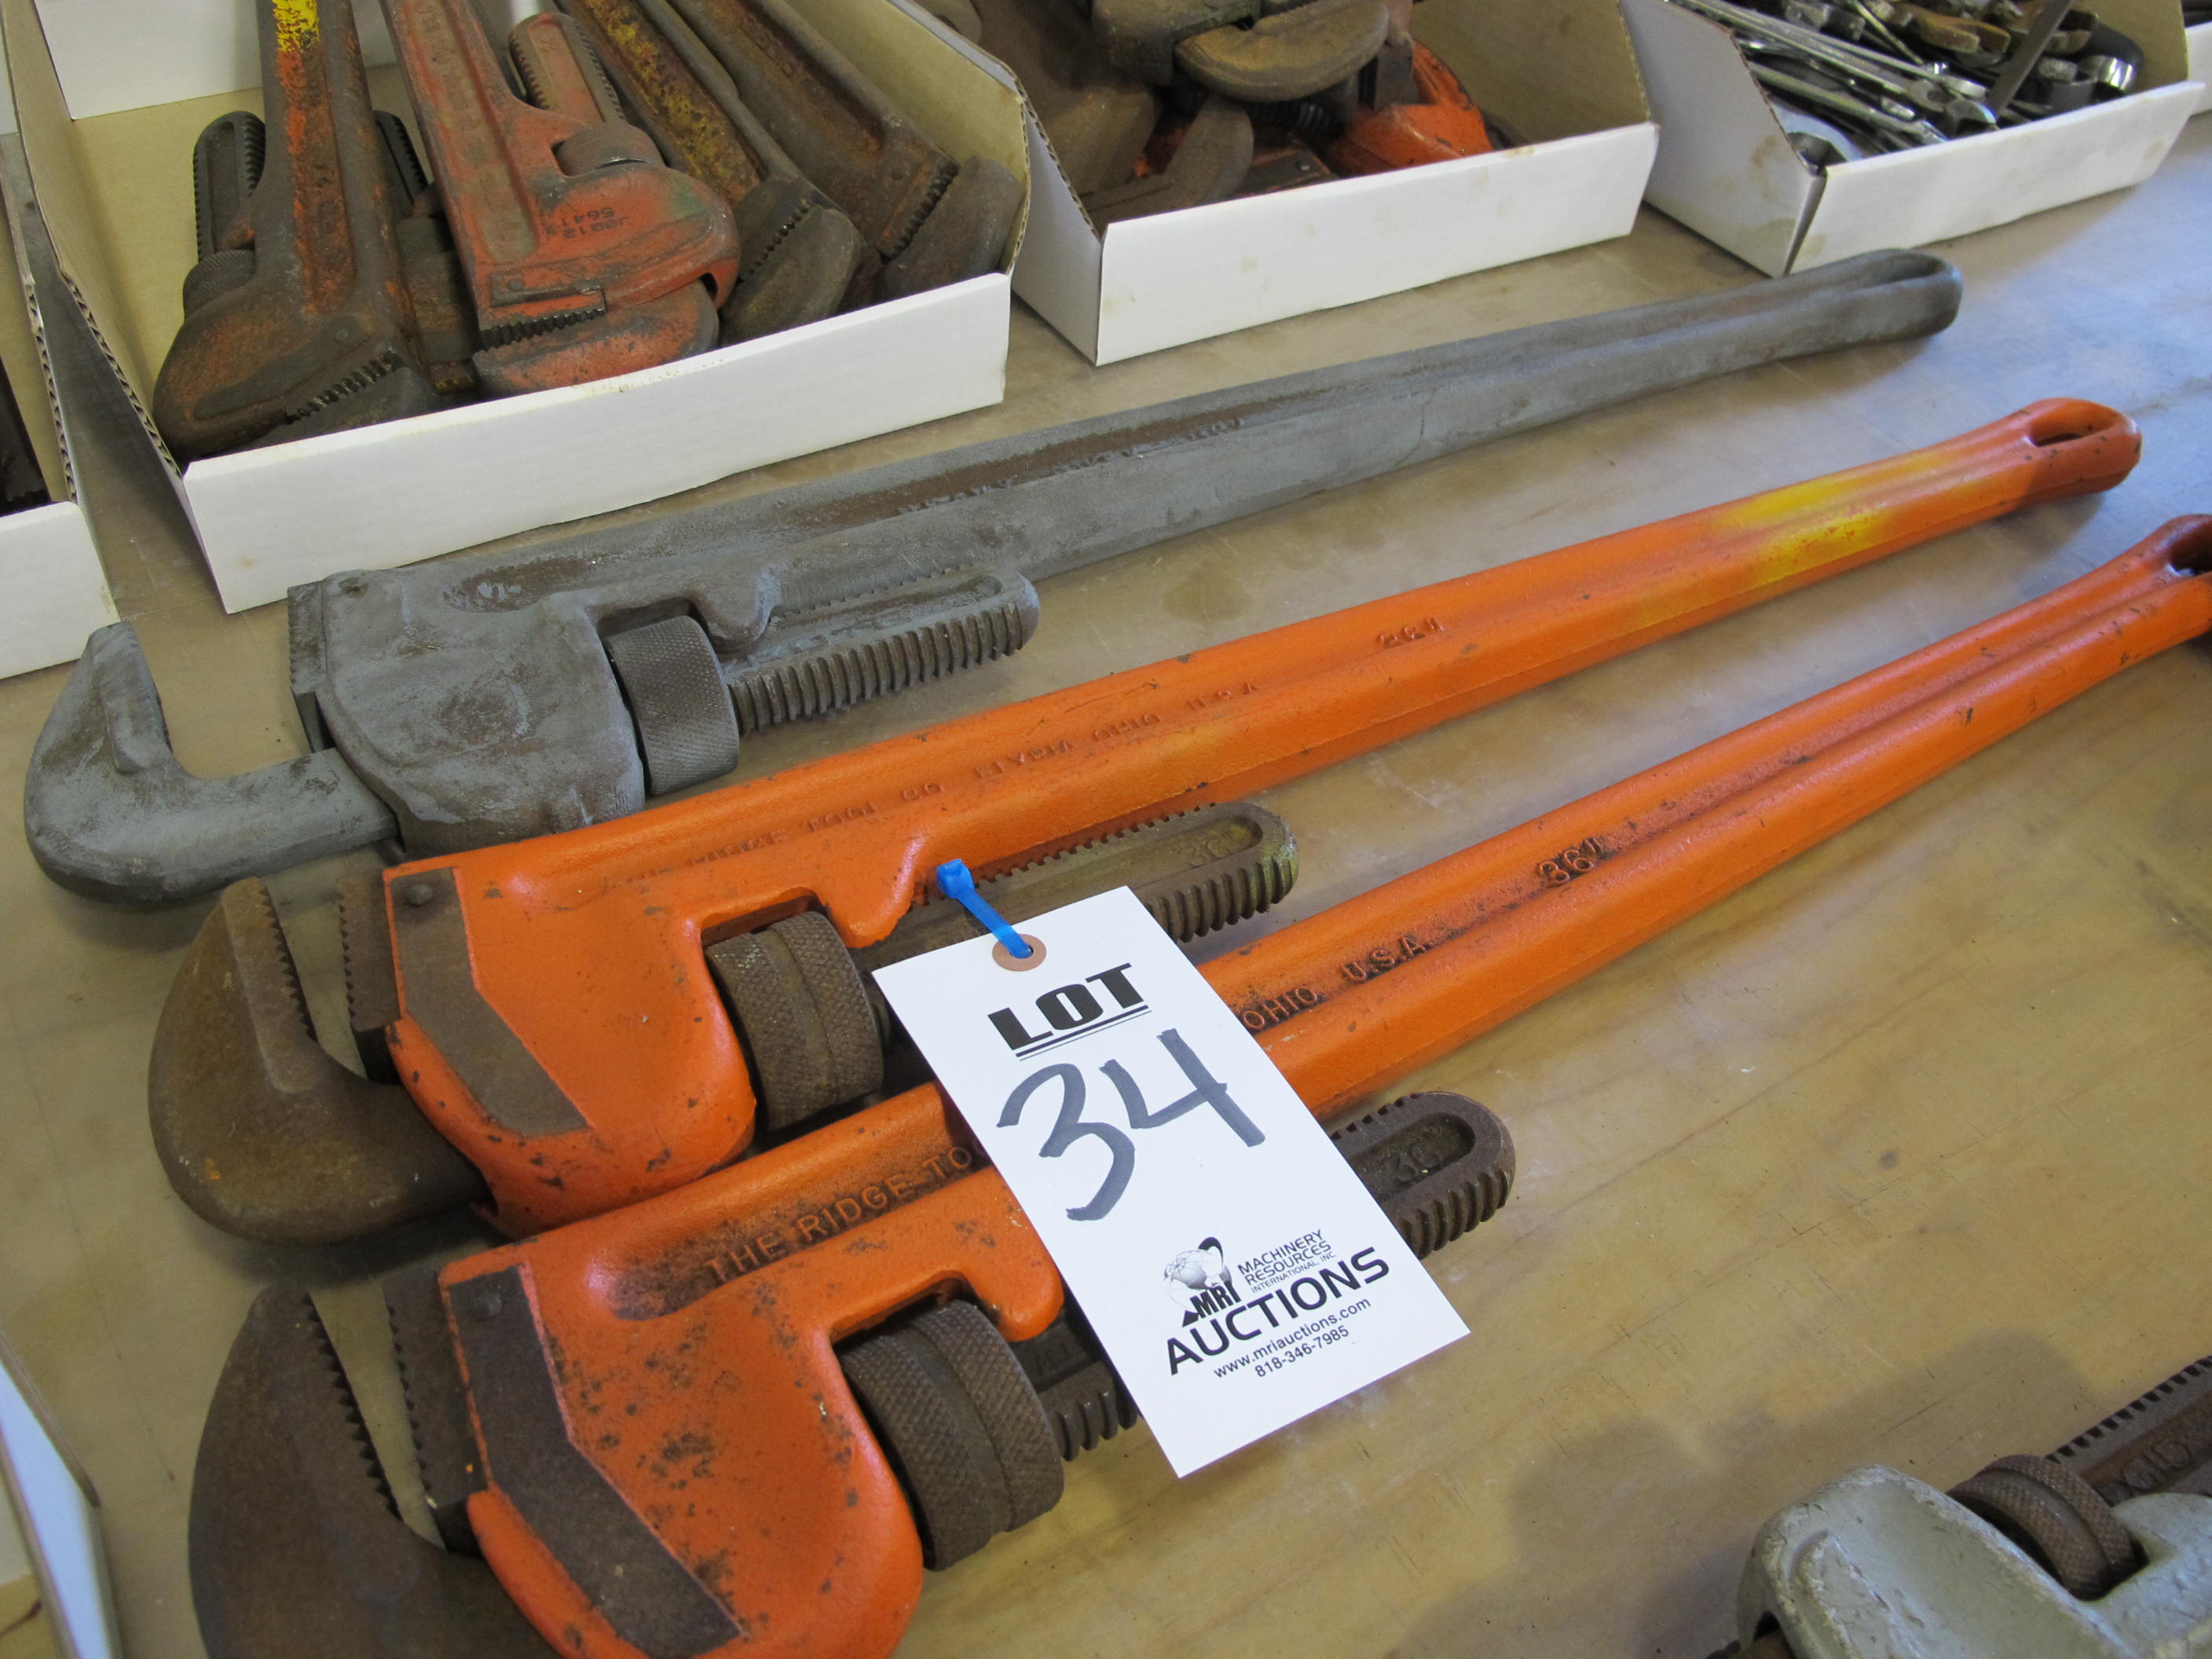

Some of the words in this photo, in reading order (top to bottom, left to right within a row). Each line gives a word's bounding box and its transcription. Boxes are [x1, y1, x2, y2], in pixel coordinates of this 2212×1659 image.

[987, 963, 1144, 1051] LOT
[1241, 984, 1320, 1031] OHIO
[996, 1028, 1265, 1221] 34
[705, 1231, 786, 1284] THE
[796, 1174, 916, 1242] RIDGE
[921, 1145, 972, 1178] TO
[1237, 1229, 1324, 1275] MACHINERY
[1244, 1240, 1331, 1286] RESOURCES
[1166, 1247, 1390, 1375] AUCTIONS
[1189, 1280, 1241, 1319] MRI
[1214, 1296, 1372, 1379] www.mriauctions.com
[1254, 1325, 1350, 1378] 818-346-7985
